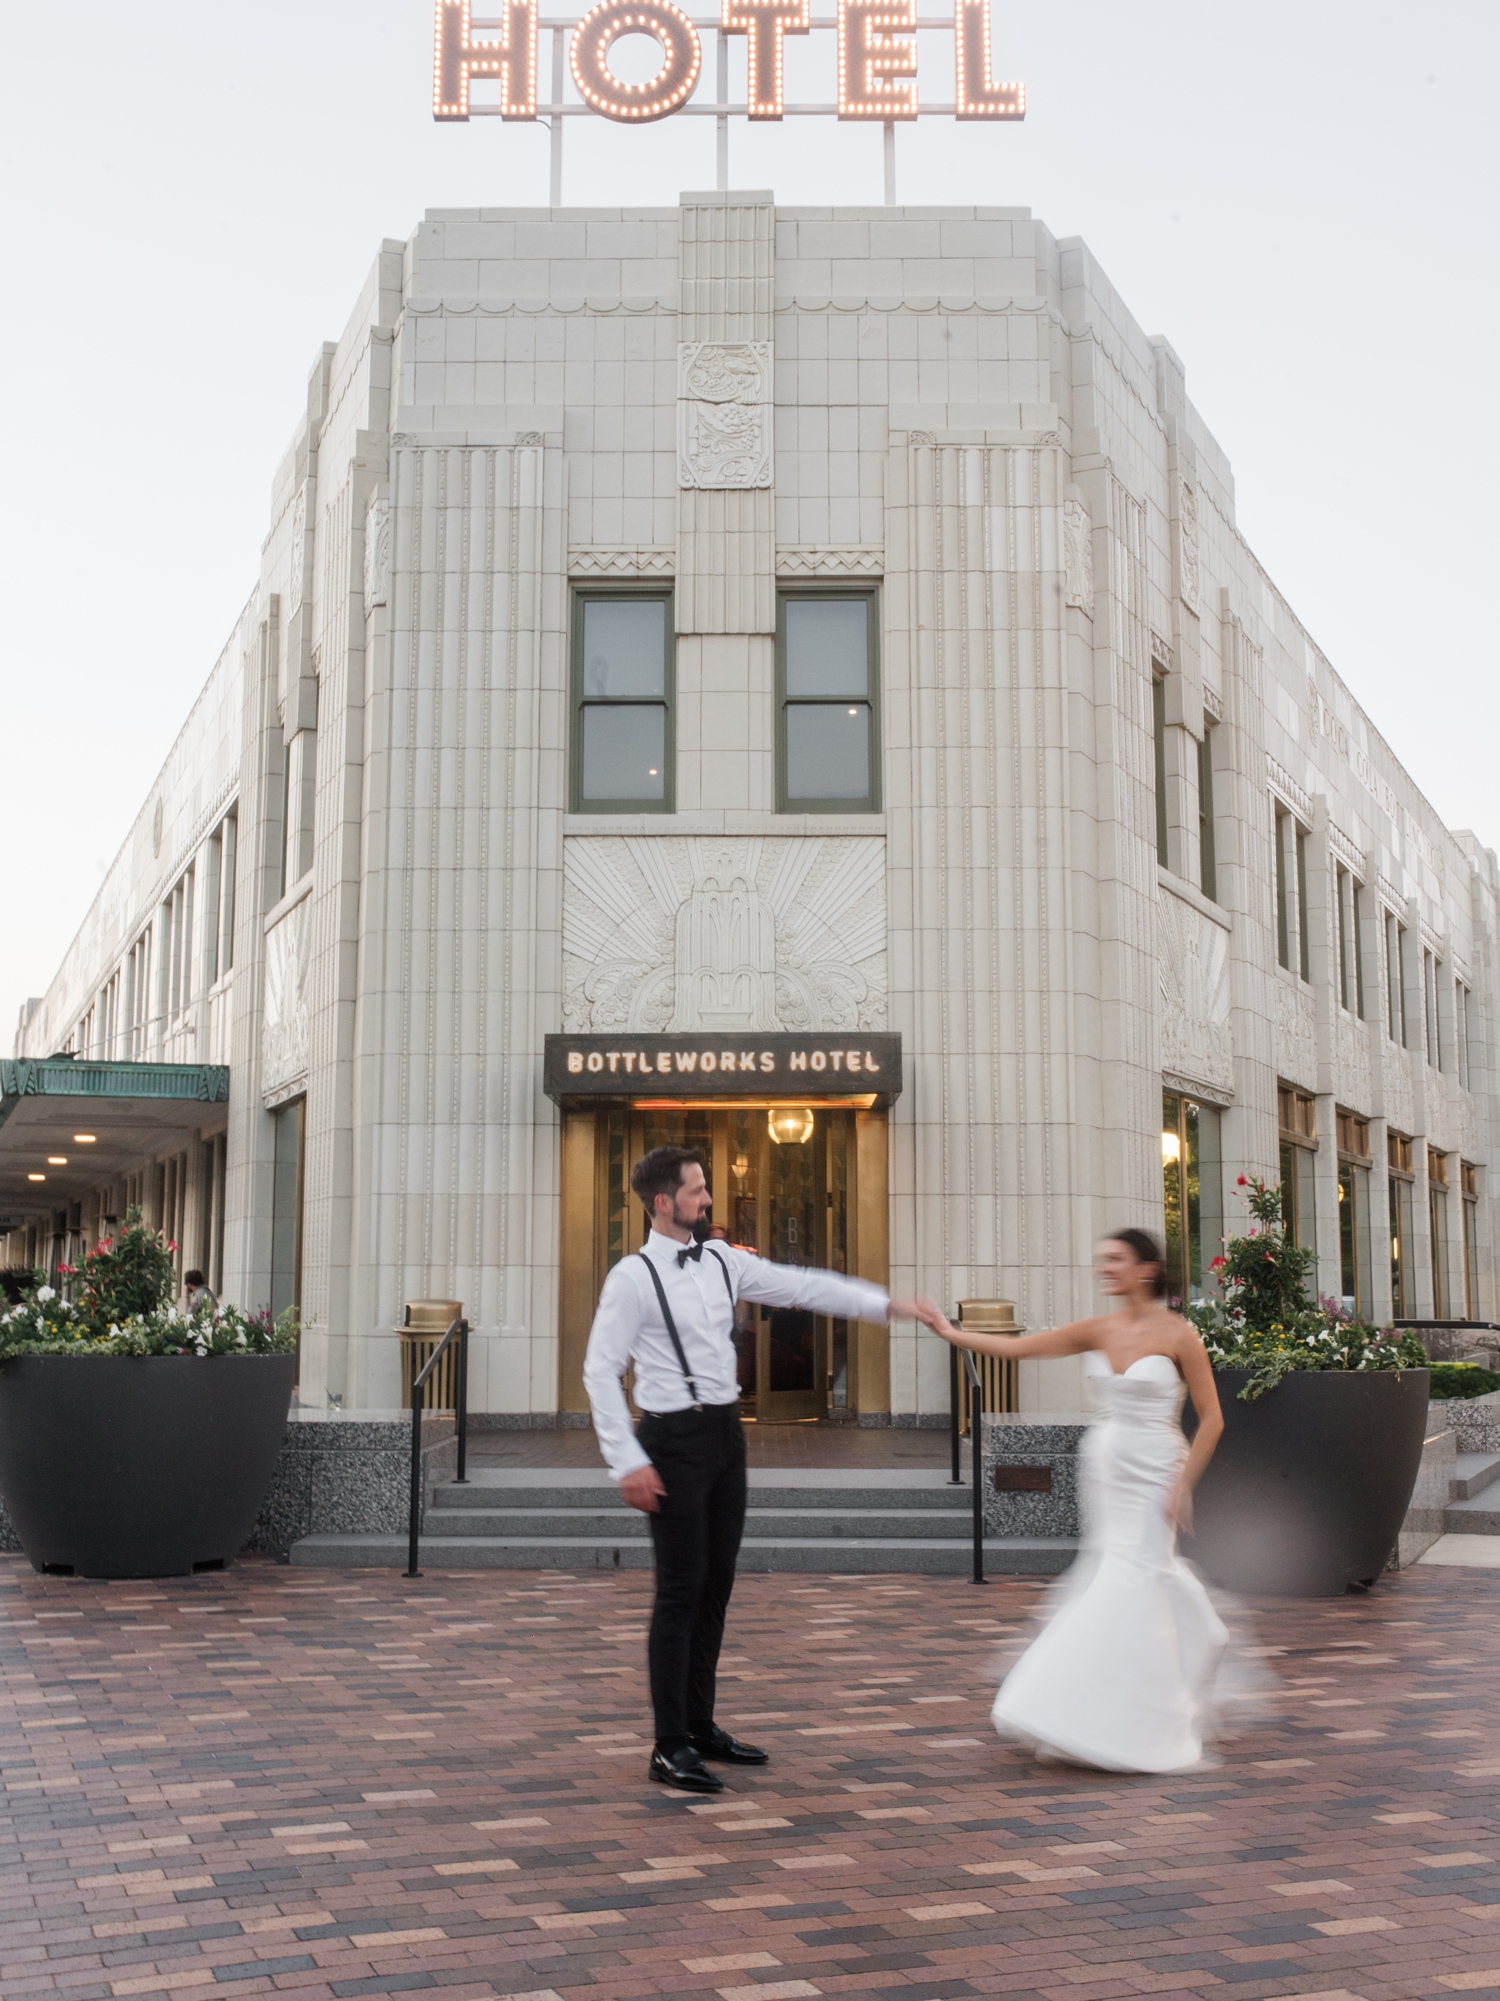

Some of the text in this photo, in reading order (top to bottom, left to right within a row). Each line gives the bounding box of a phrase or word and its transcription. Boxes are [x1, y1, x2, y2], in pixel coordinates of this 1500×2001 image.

[433, 0, 1026, 123] HOTEL
[567, 1050, 880, 1073] BOTTLEWORKS HOTEL
